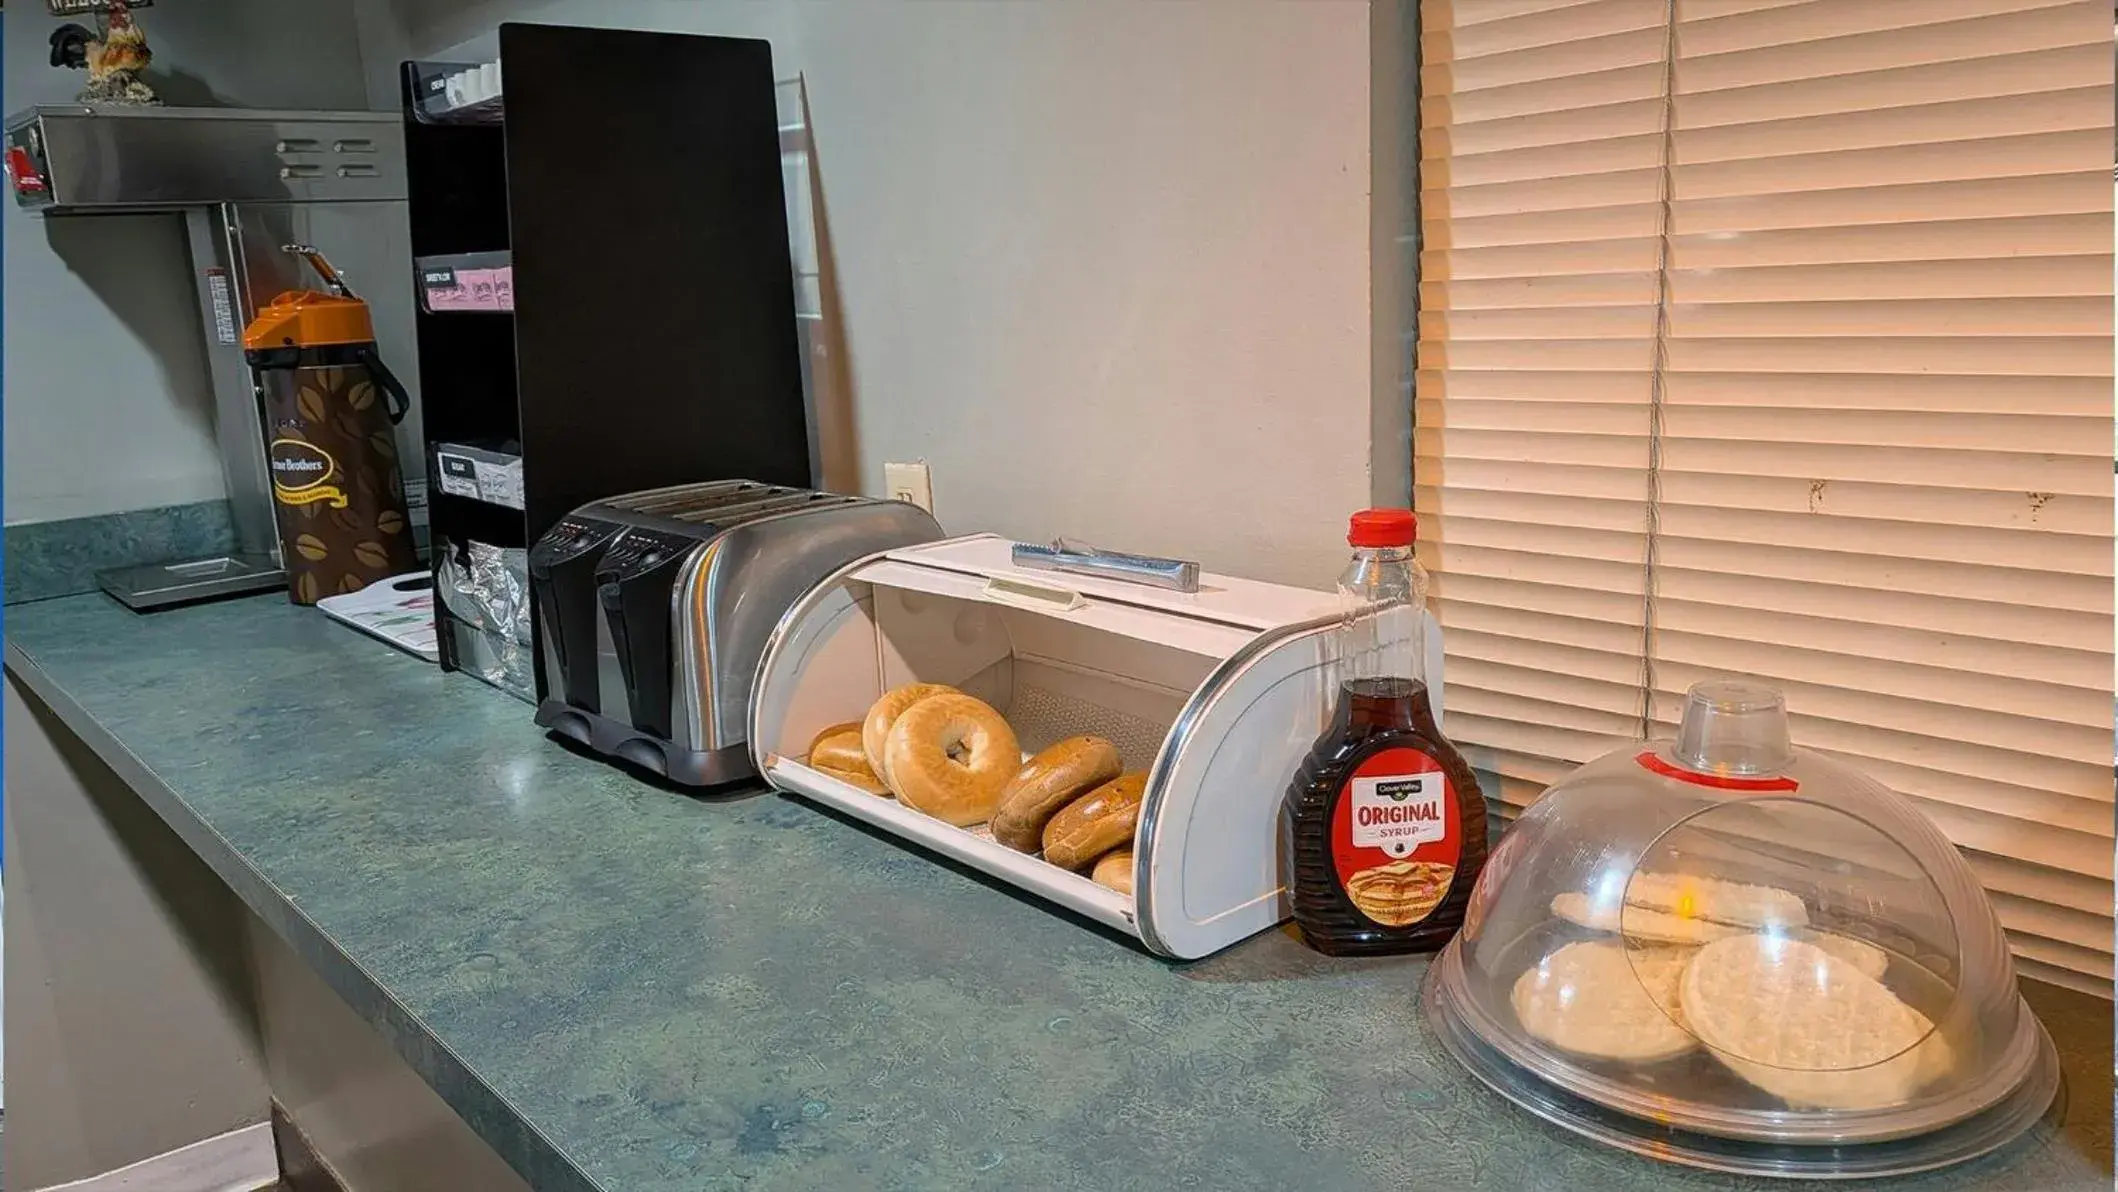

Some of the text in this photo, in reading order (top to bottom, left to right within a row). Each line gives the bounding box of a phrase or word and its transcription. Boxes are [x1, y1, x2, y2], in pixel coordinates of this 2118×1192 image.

[286, 458, 323, 471] Brothers
[1379, 783, 1421, 793] Clover Valley
[1358, 801, 1440, 826] ORIGINAL
[1380, 827, 1419, 838] SYRUP
